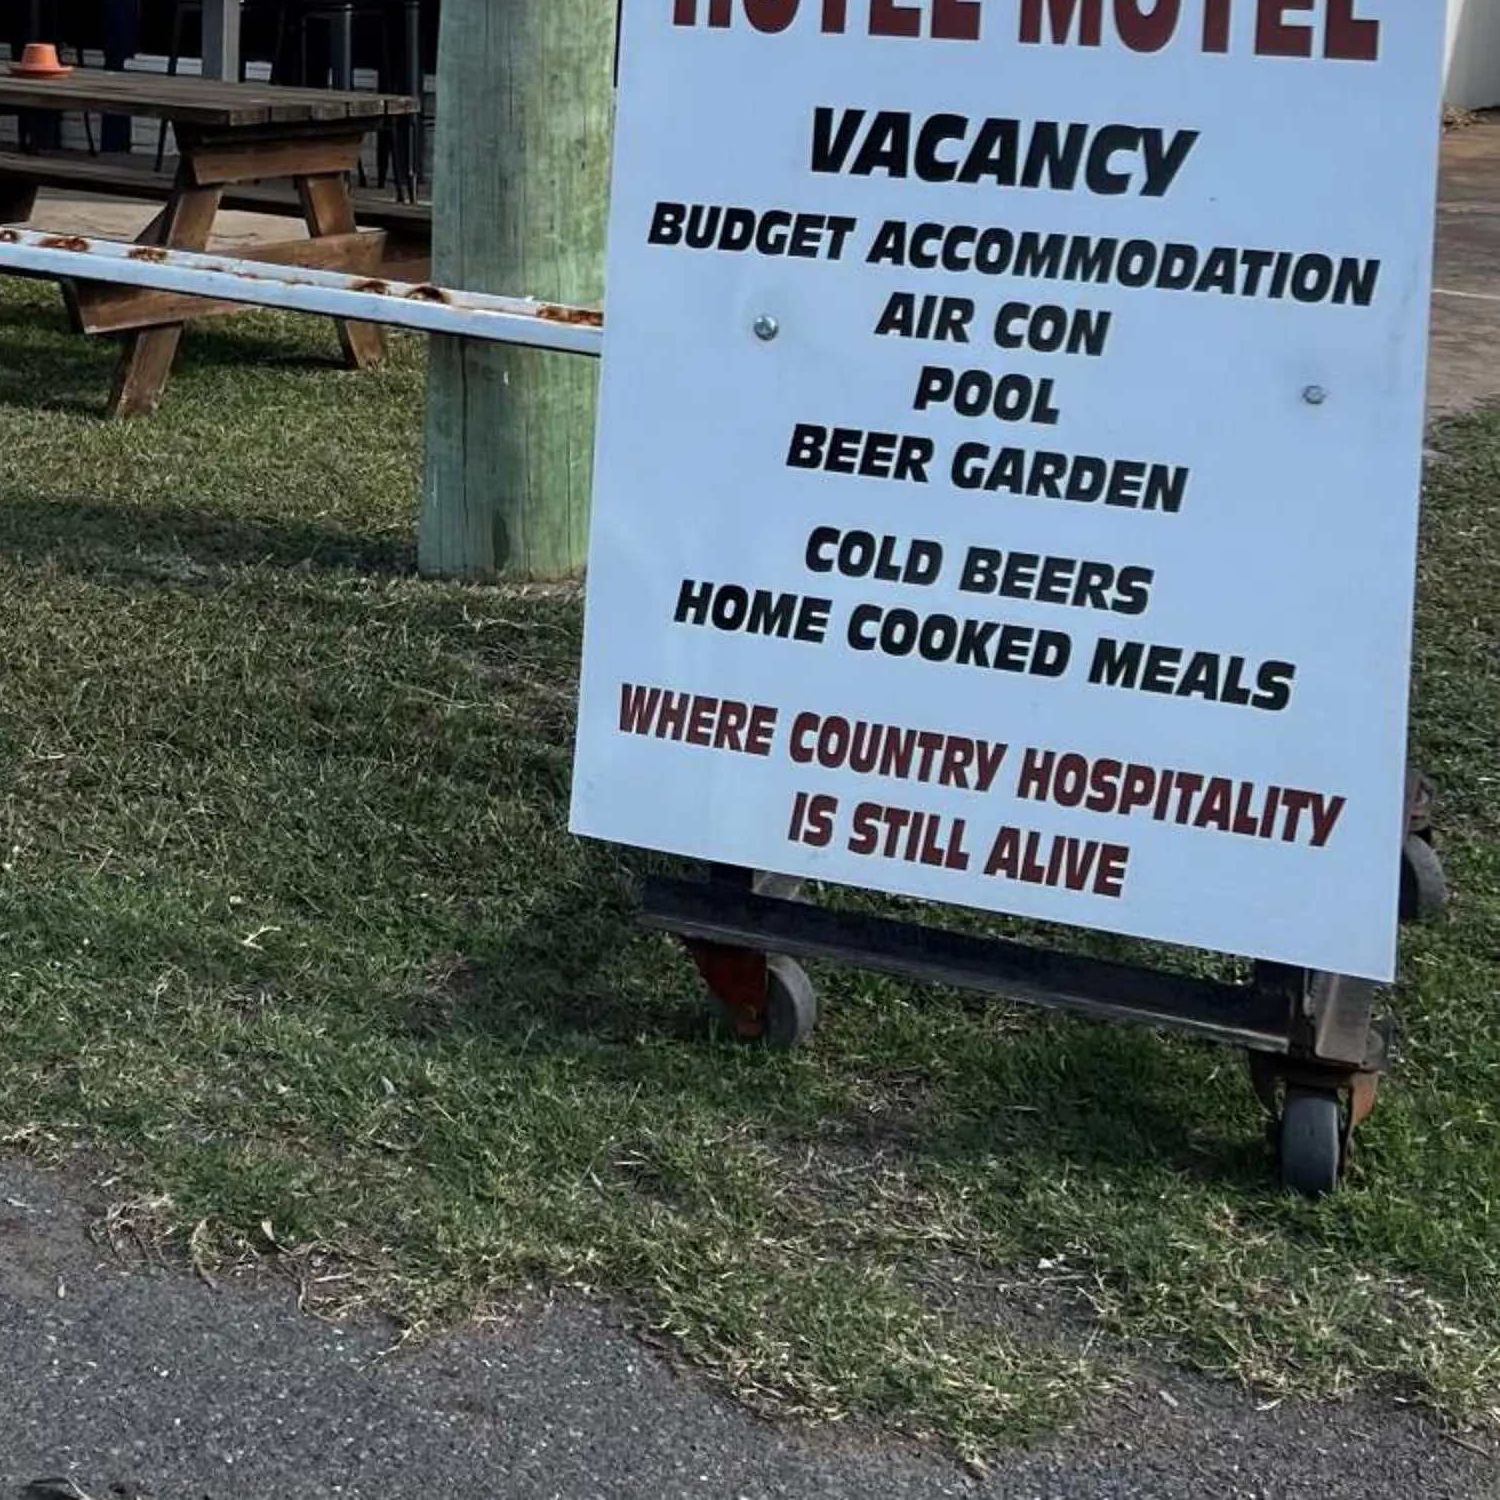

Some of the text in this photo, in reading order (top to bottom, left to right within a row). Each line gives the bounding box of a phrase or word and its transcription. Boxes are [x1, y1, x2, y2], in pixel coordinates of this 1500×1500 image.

[811, 106, 1200, 197] VACANCY
[647, 201, 1381, 307] BUDGET ACCOMMODATION
[873, 291, 1112, 357] AIR CON
[912, 365, 1060, 425] POOL
[785, 423, 1189, 513] BEER GARDEN
[805, 526, 1155, 615] COLD BEERS
[673, 579, 1296, 711] HOME COOKED MEALS
[619, 683, 1347, 847] WHERE COUNTRY HOSPITALITY
[787, 791, 1130, 898] IS STILL ALIVE
